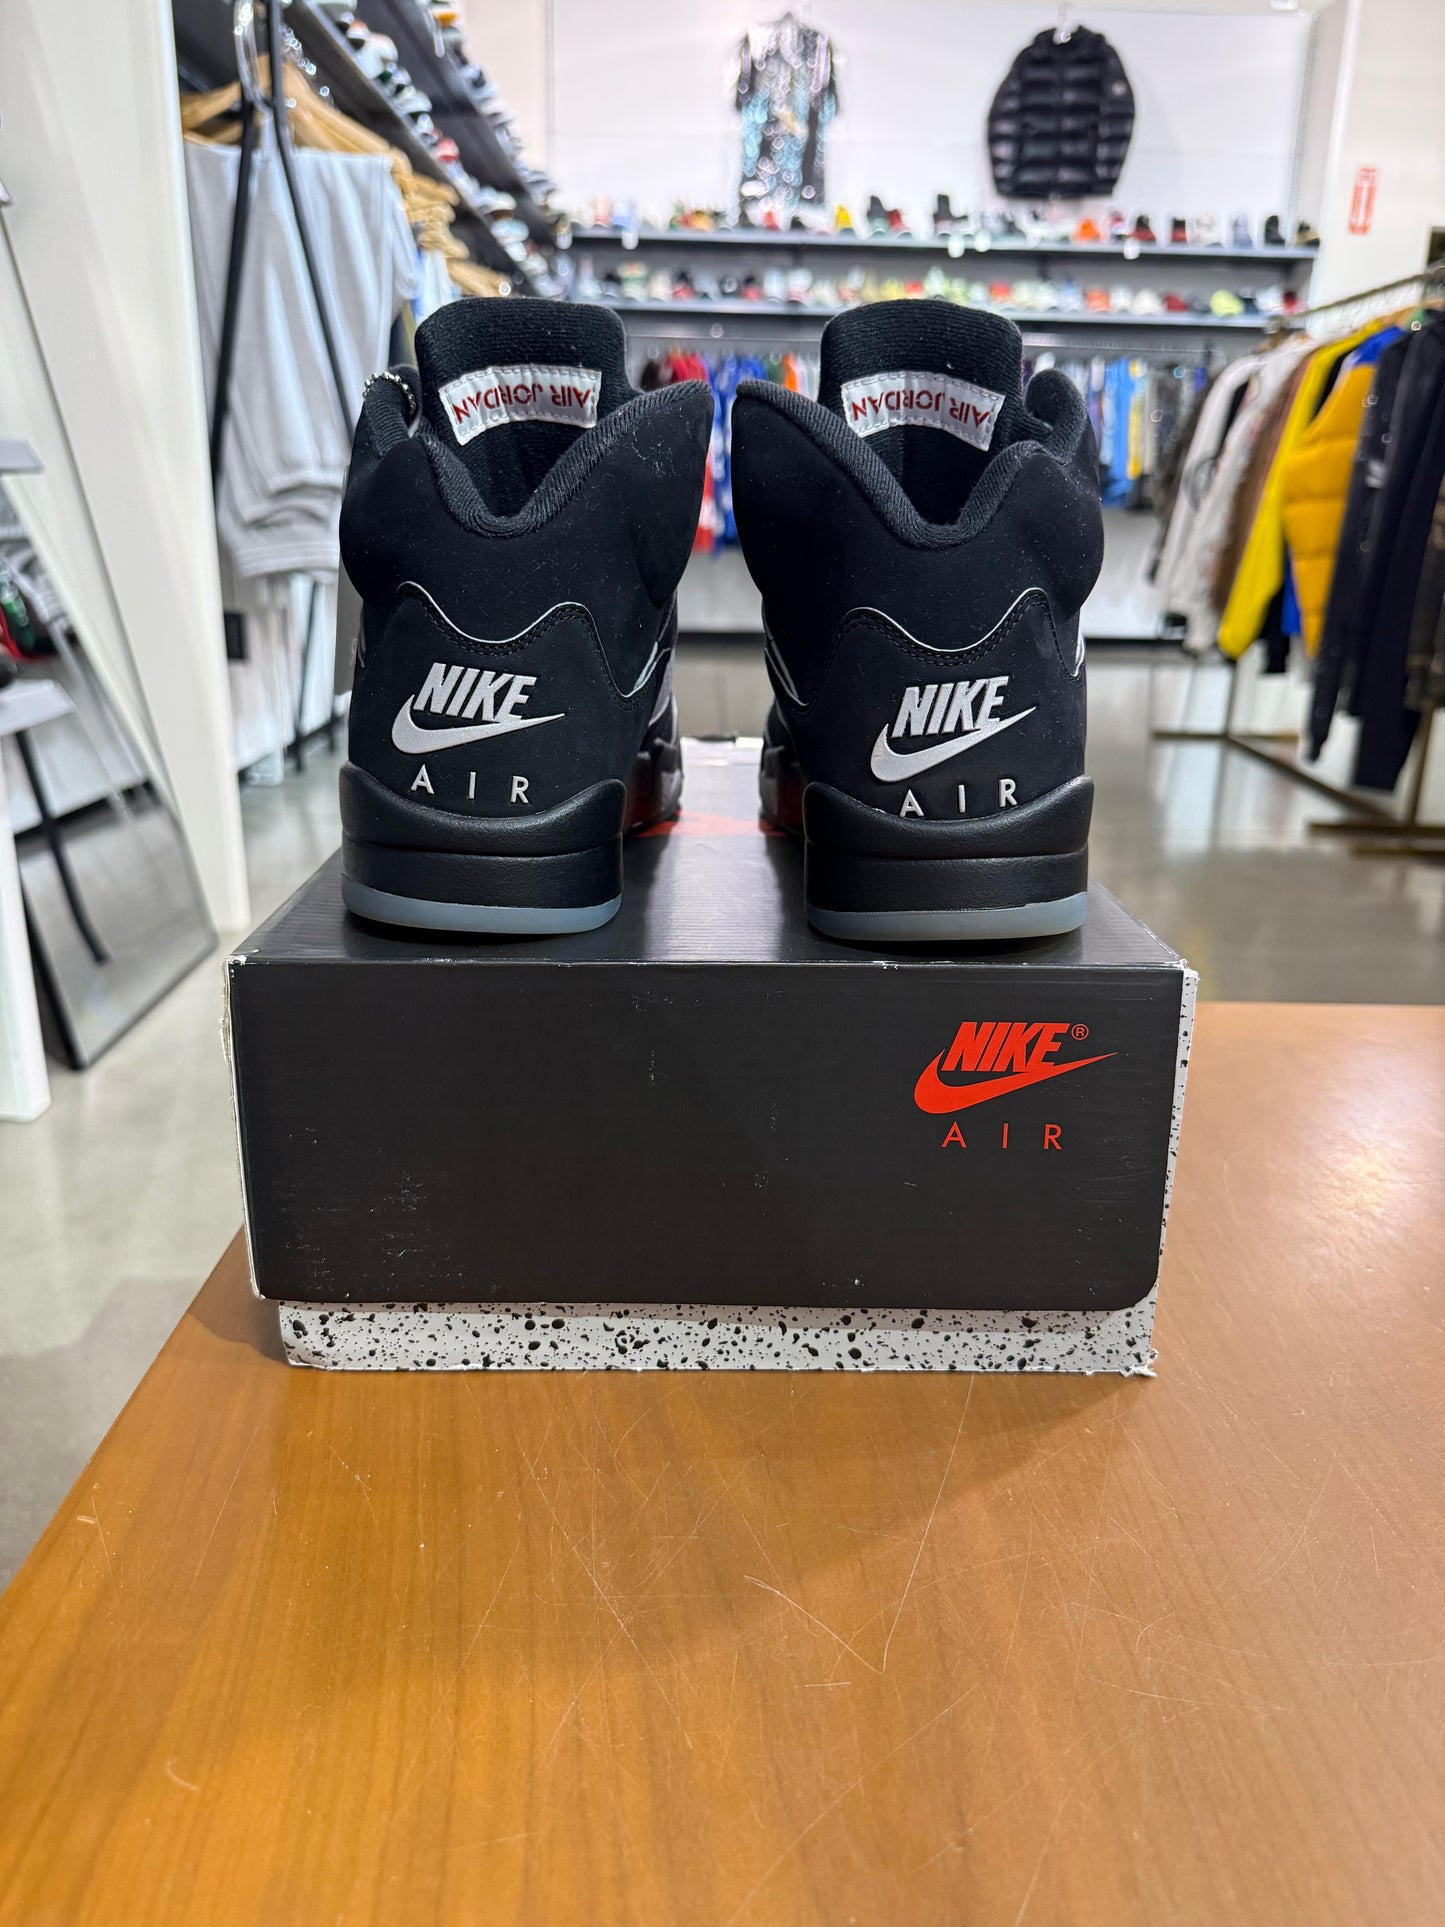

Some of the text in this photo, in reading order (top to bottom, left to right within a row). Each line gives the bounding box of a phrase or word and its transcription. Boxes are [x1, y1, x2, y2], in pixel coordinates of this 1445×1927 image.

[452, 383, 592, 424] AIR JORDAN
[851, 389, 991, 429] AIR JORDAN
[413, 662, 537, 722] NIKE
[891, 675, 1009, 739] NIKE
[410, 763, 530, 804] AIR
[900, 778, 1018, 817] AIR
[941, 1121, 1062, 1150] AIR
